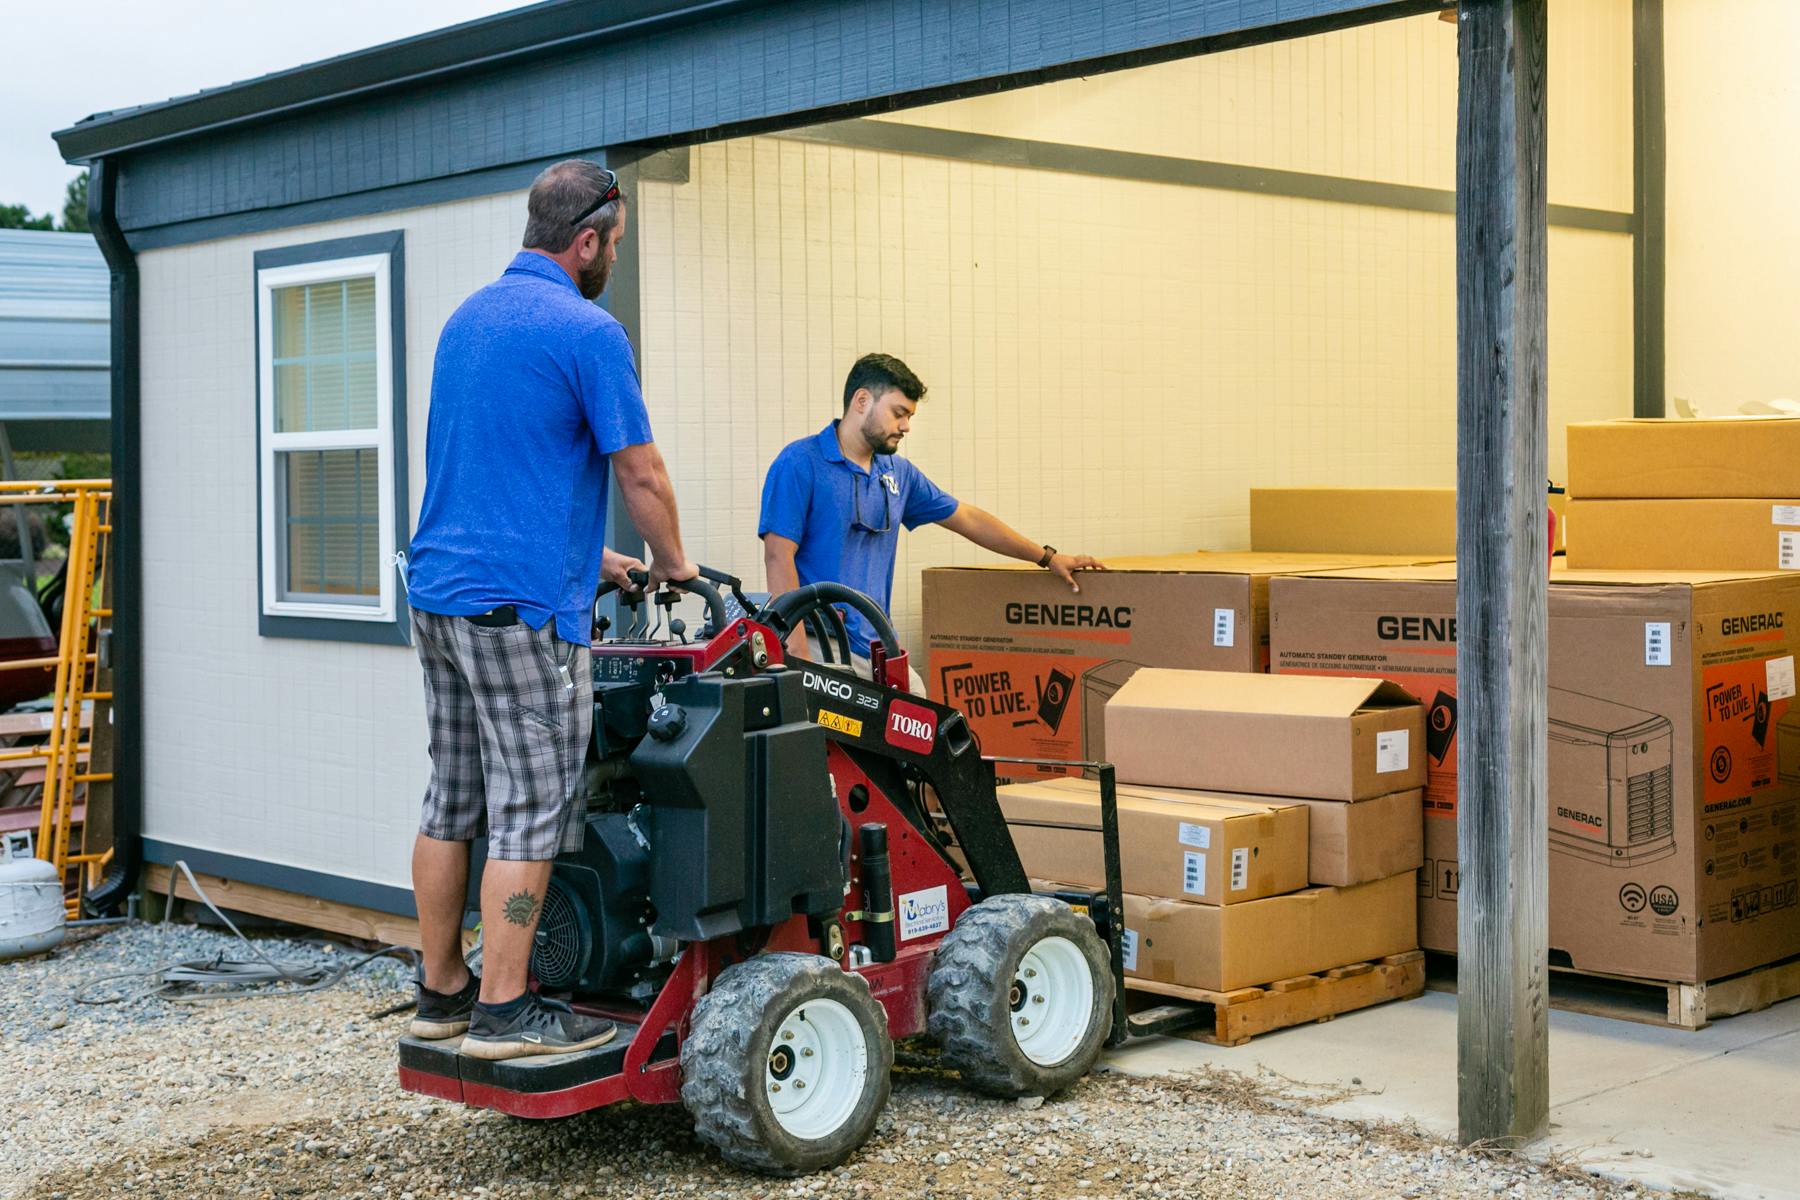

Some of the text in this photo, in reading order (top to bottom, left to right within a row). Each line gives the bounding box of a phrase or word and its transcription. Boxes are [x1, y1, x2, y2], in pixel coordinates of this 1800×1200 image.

[1005, 602, 1132, 628] GENERAC
[1721, 611, 1784, 636] GENERAC
[1280, 651, 1315, 659] AUTOMATIC
[803, 671, 879, 709] DINGO 323
[953, 671, 1012, 698] POWER
[1713, 684, 1743, 709] POWER
[964, 692, 1031, 719] TO LIVE.
[1719, 705, 1731, 722] TO
[891, 713, 933, 741] TORO
[1557, 806, 1602, 828] GENERAC
[1653, 893, 1675, 905] USA
